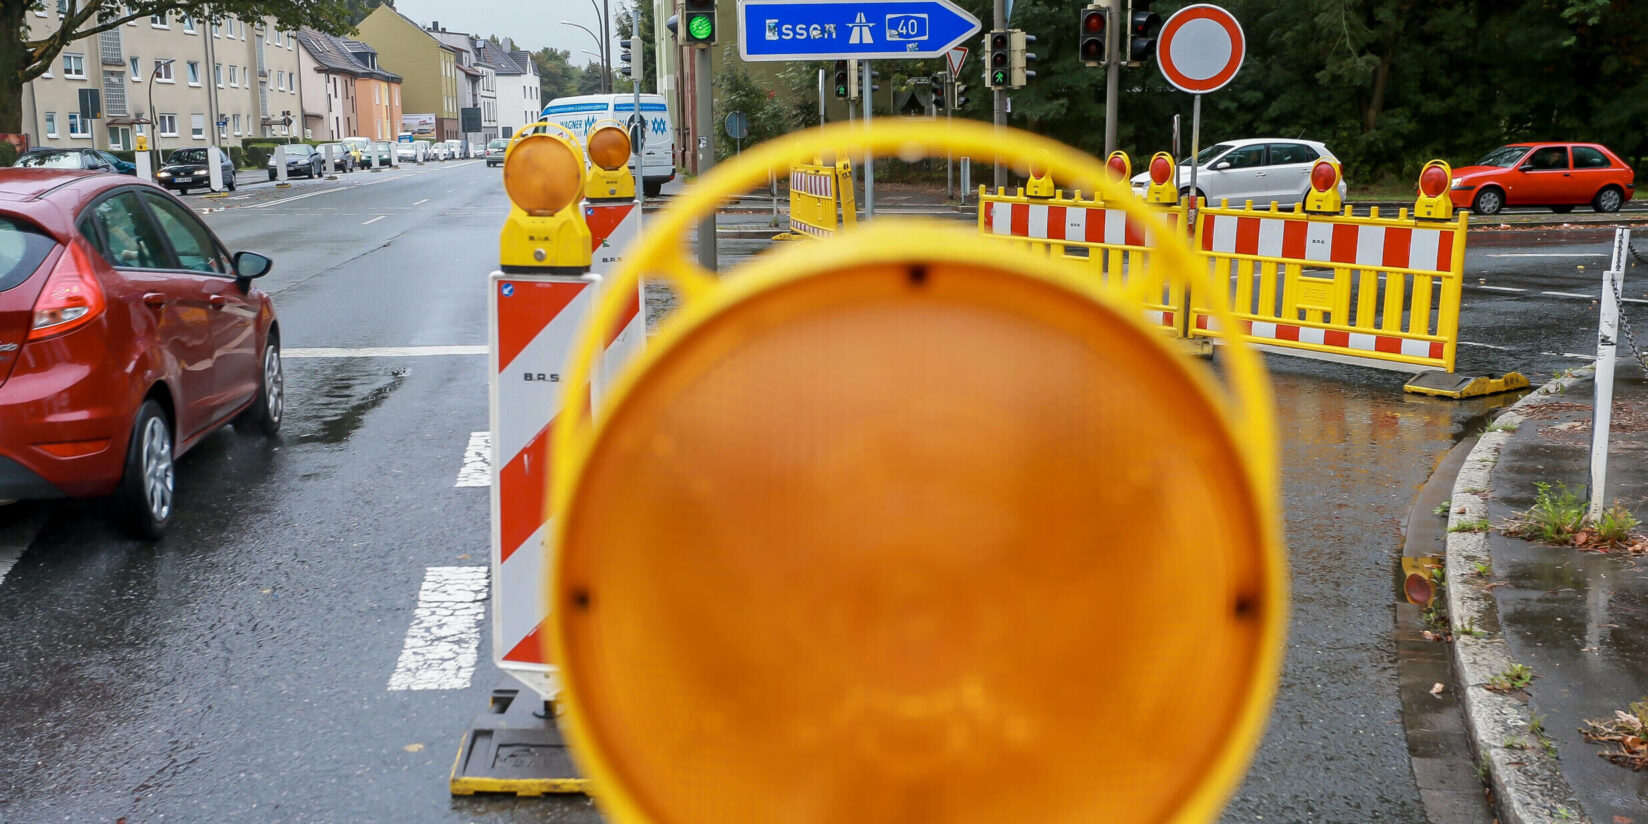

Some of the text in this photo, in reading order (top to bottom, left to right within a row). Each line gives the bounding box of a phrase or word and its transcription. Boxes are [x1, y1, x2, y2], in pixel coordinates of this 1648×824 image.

[765, 18, 918, 41] Essen 40
[560, 119, 583, 130] WAGNER
